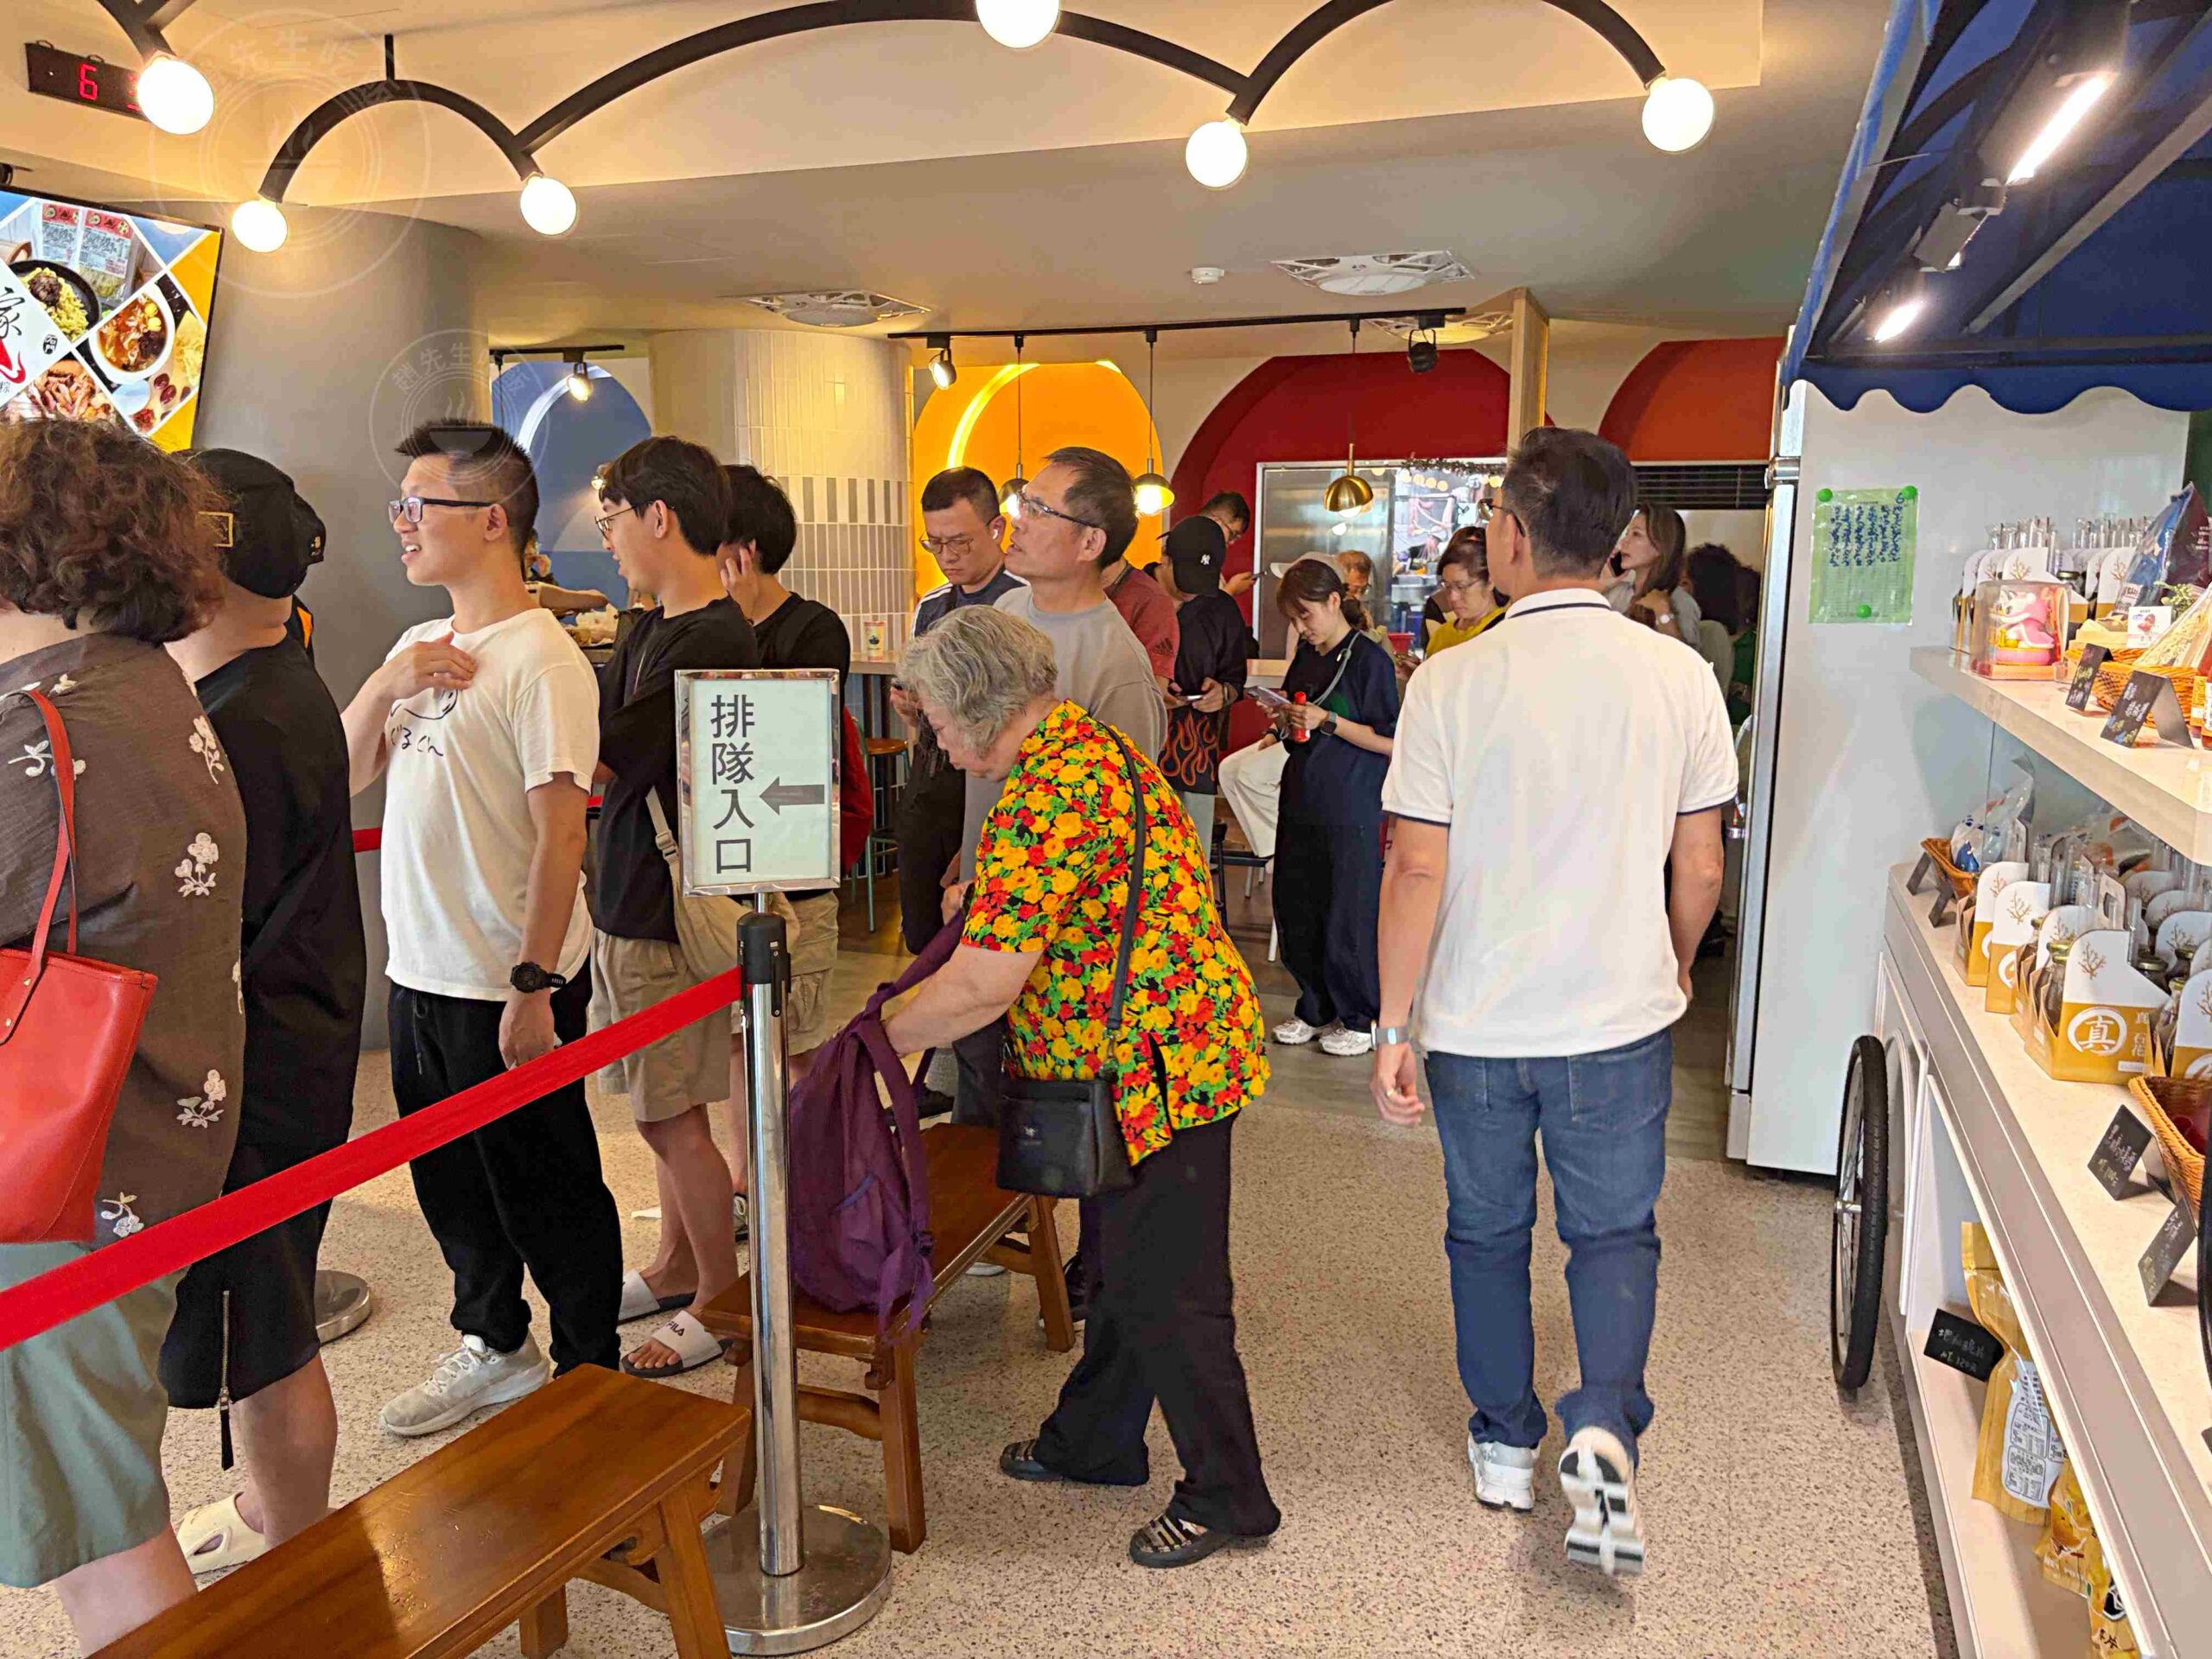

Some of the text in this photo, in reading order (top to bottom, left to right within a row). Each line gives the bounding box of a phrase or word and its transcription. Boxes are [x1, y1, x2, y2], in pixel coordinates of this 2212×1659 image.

[710, 694, 756, 874] 排隊入口
[2078, 1014, 2116, 1051] 真
[667, 1320, 685, 1337] FILA
